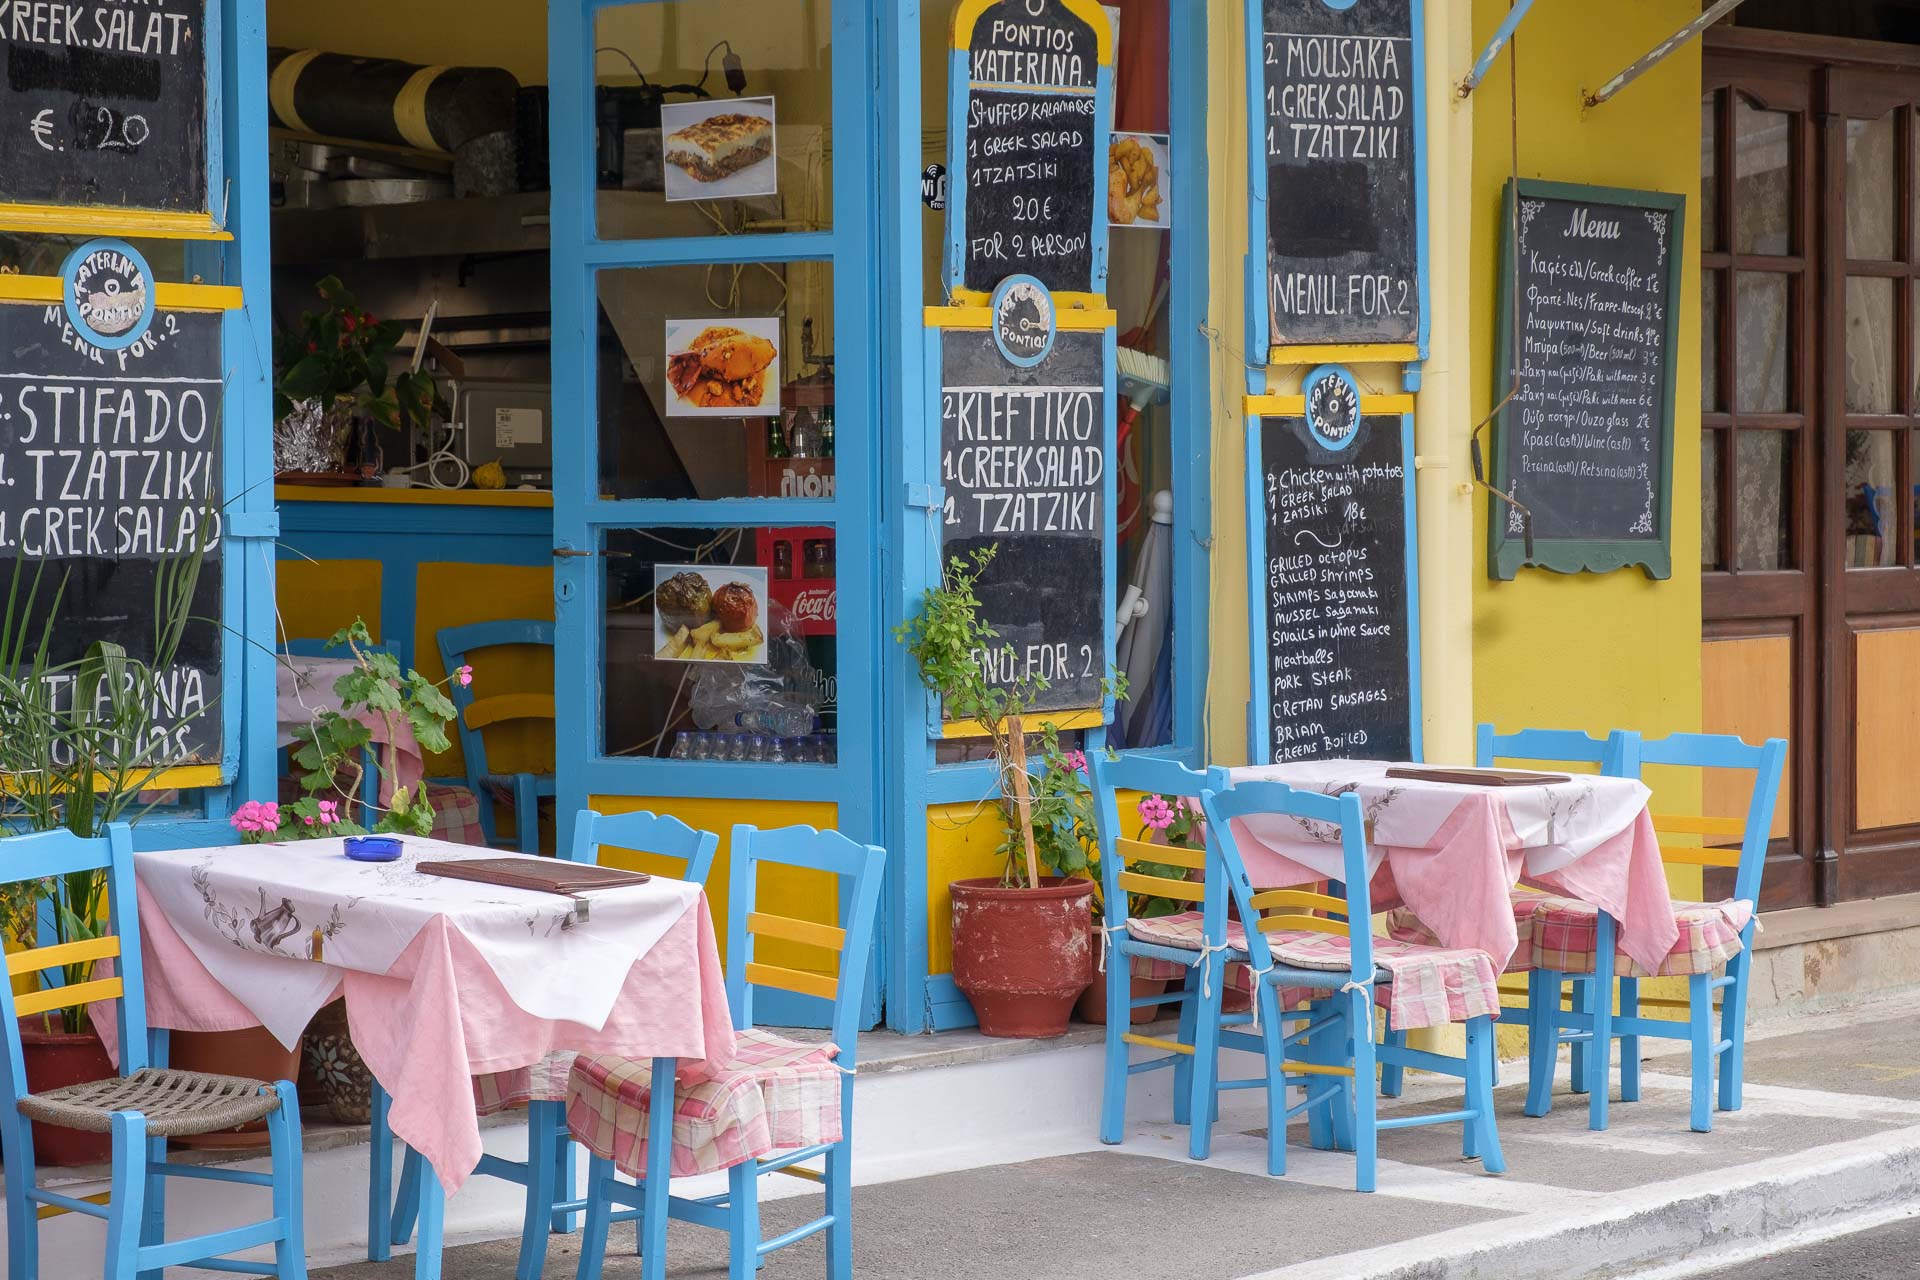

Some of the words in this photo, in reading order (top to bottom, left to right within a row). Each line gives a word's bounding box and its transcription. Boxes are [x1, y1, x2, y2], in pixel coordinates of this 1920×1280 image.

[992, 20, 1074, 52] PONTIOS
[1287, 38, 1399, 79] MOUSAKA
[98, 107, 149, 148] 20
[1290, 123, 1398, 158] TZATZIKI
[969, 139, 977, 158] 1
[983, 136, 1028, 157] GREEK
[1031, 131, 1083, 149] SALAD
[1564, 208, 1621, 239] Menu
[972, 231, 1008, 260] FOR
[1012, 235, 1026, 257] 2
[1031, 232, 1086, 257] PERSON
[44, 306, 105, 365] MENU
[18, 385, 207, 443] STIFADO
[958, 391, 1093, 441] KLEFTIKO
[1607, 412, 1628, 433] glass
[25, 450, 214, 500] TZATZIKI
[1267, 473, 1277, 492] 2
[1335, 465, 1359, 481] with
[1270, 494, 1276, 509] 1
[1281, 491, 1315, 508] GREEK
[1321, 485, 1352, 502] SALAD
[972, 491, 1096, 533] TZATZIKI
[1272, 515, 1277, 526] 1
[1270, 554, 1313, 574] GRILLED
[1270, 568, 1317, 588] GRILLED
[1275, 608, 1320, 626] MUSSEL
[1318, 625, 1328, 638] in
[1274, 675, 1302, 696] PORK
[1273, 699, 1323, 718] CRETAN
[1275, 743, 1318, 763] GREENS
